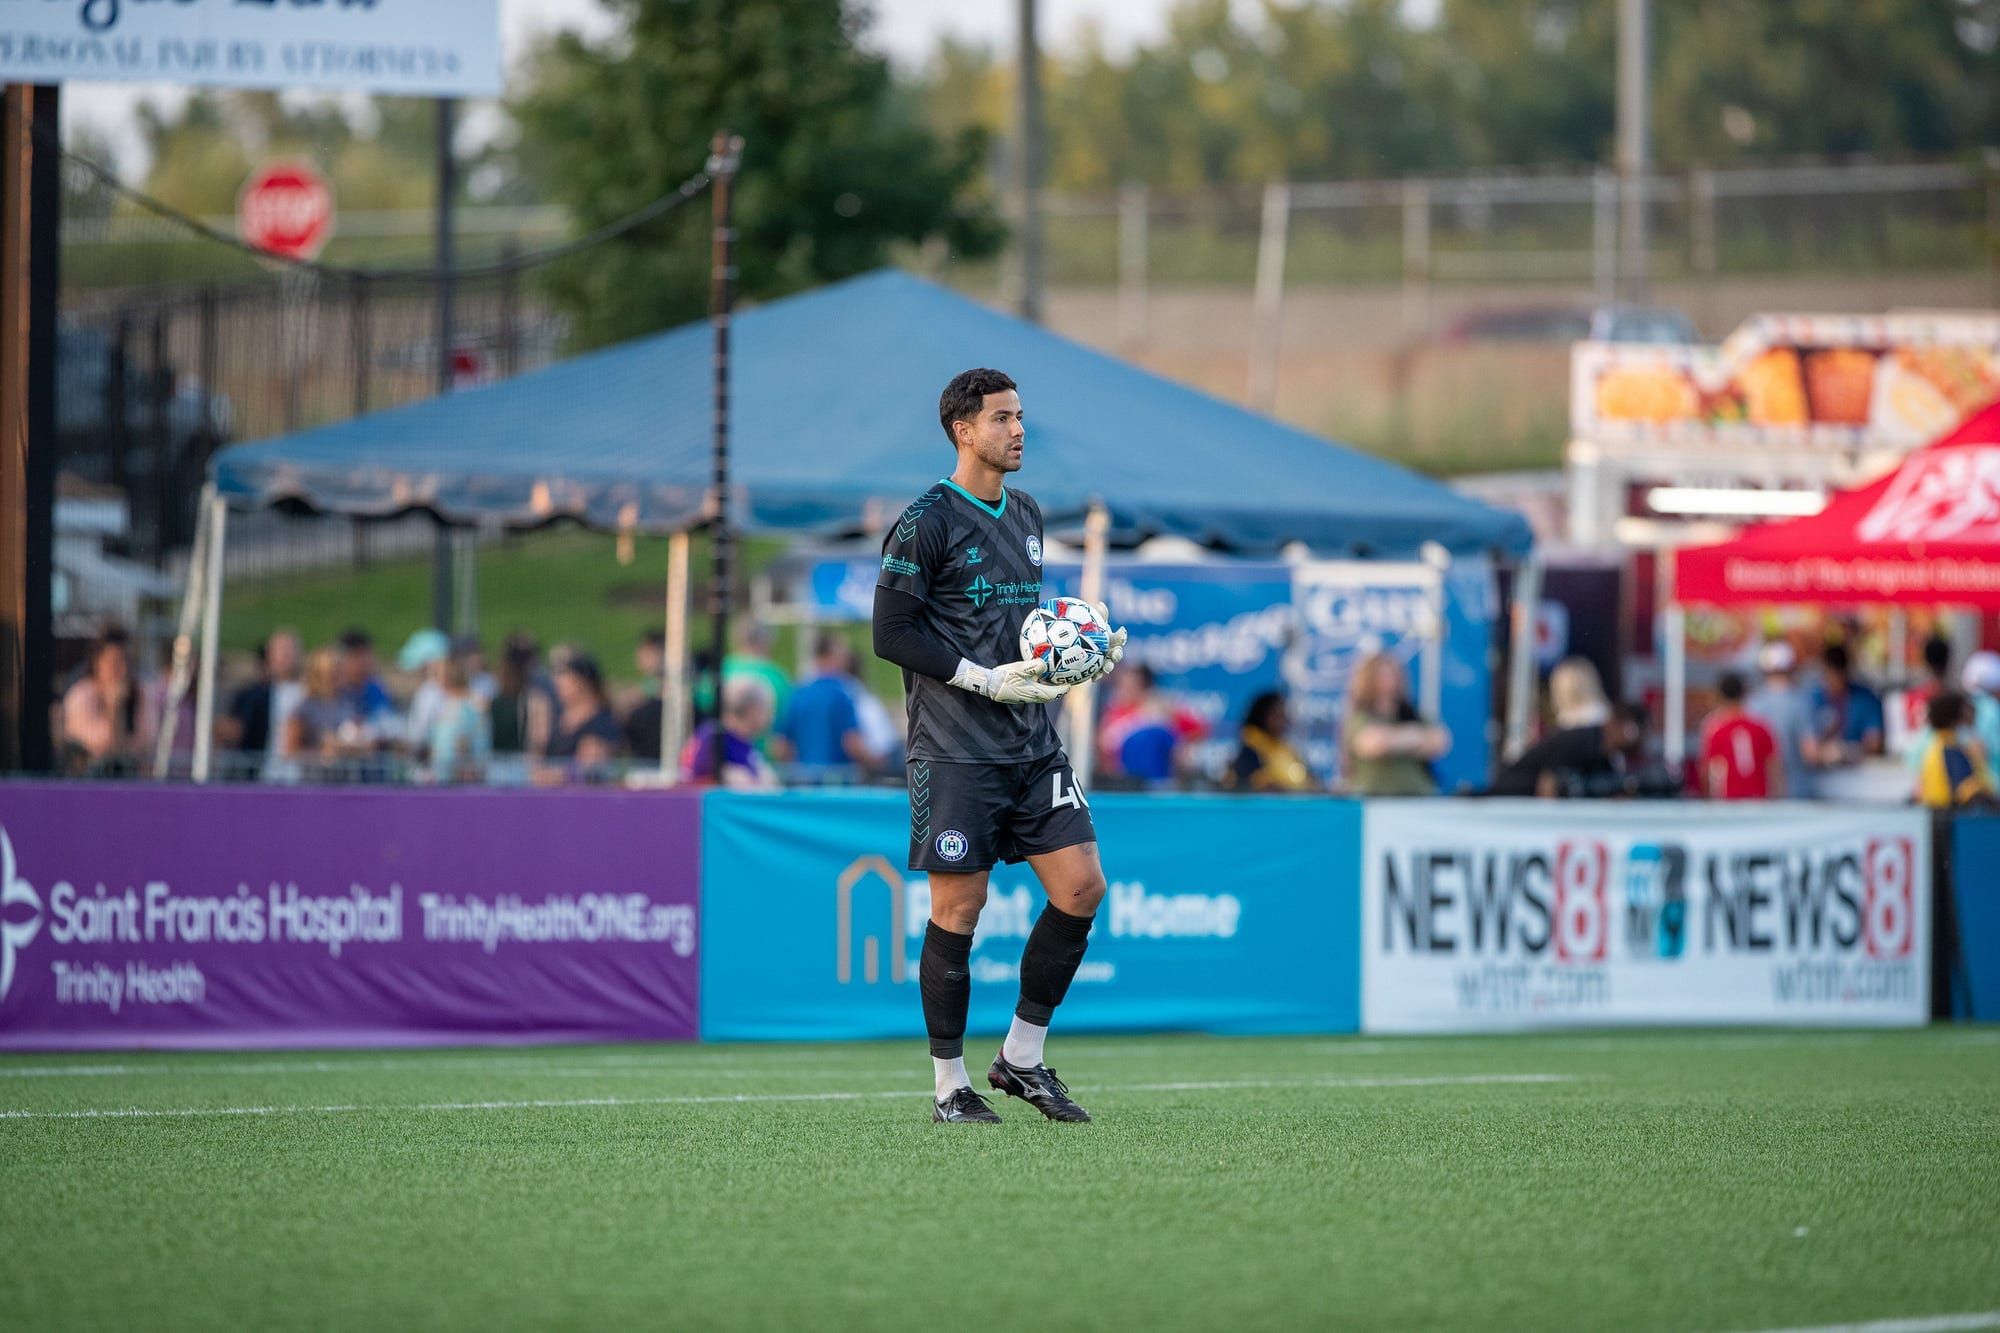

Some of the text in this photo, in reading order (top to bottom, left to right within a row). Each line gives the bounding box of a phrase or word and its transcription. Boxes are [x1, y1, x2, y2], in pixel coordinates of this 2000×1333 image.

[995, 582, 1020, 596] Trinity
[1056, 659, 1101, 684] SELECT
[50, 880, 403, 958] Saint Francis Hospital
[419, 891, 695, 958] TrinityHealthONE.org
[1108, 880, 1240, 939] Home
[52, 959, 206, 1015] Trinity Health
